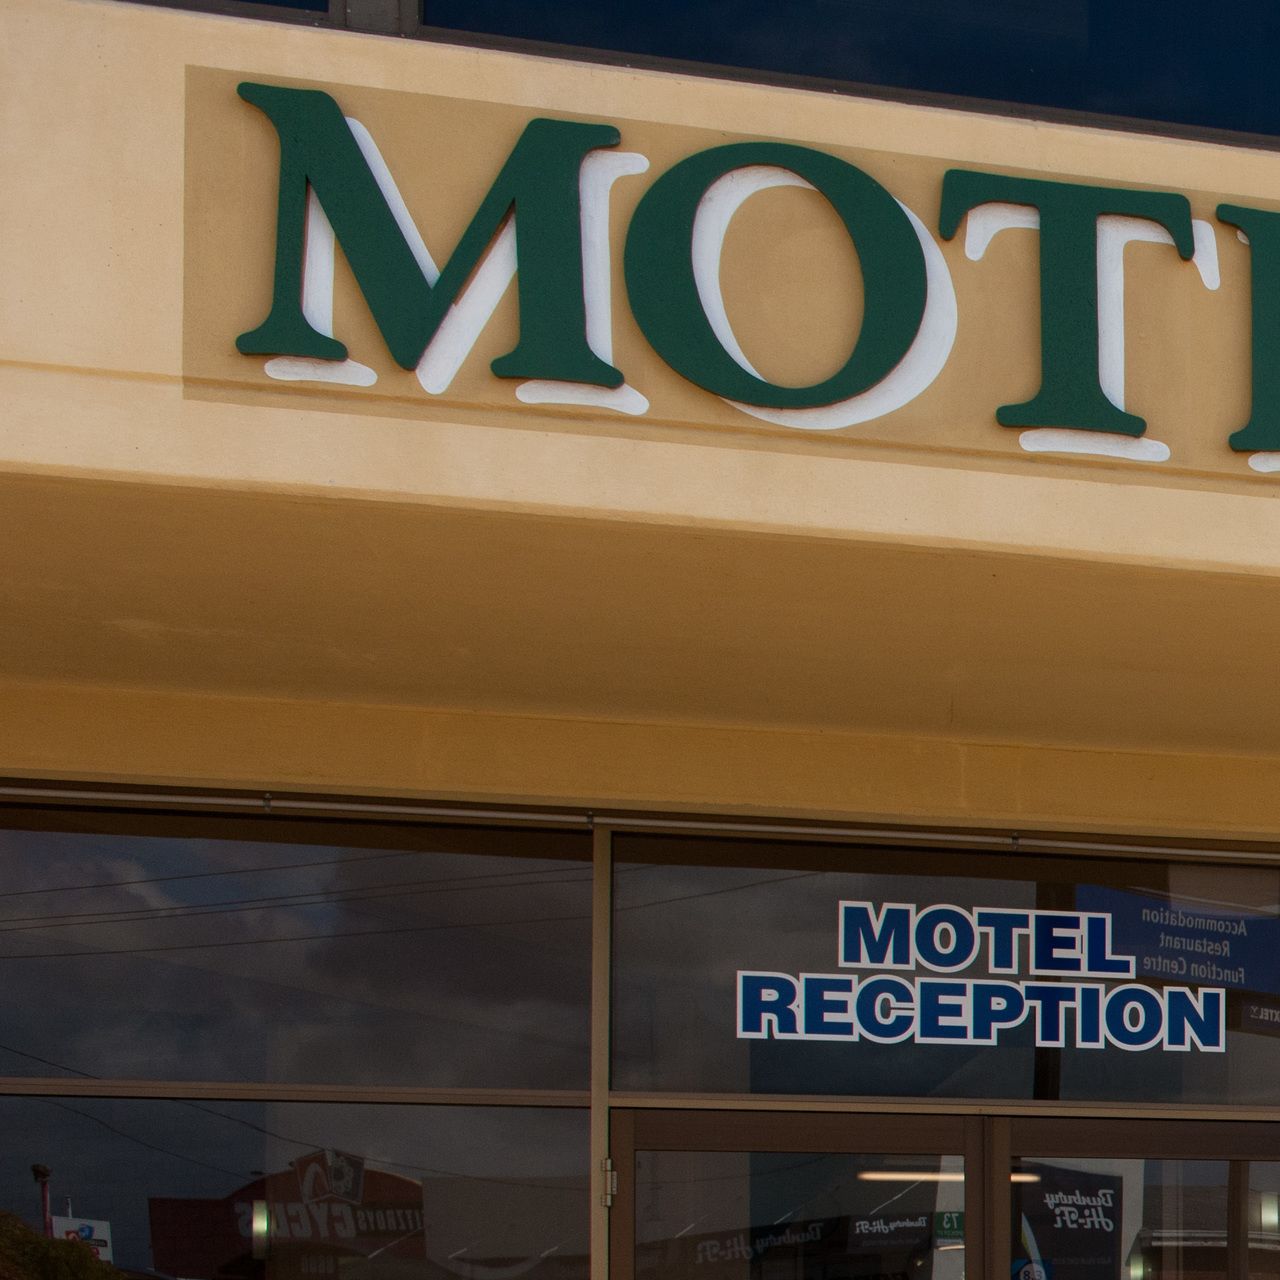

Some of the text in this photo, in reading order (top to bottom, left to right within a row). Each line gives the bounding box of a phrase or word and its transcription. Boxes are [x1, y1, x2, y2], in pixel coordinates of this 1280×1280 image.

[839, 900, 1136, 979] MOTEL
[736, 969, 1226, 1053] RECEPTION
[1023, 1270, 1042, 1280] 8.3
